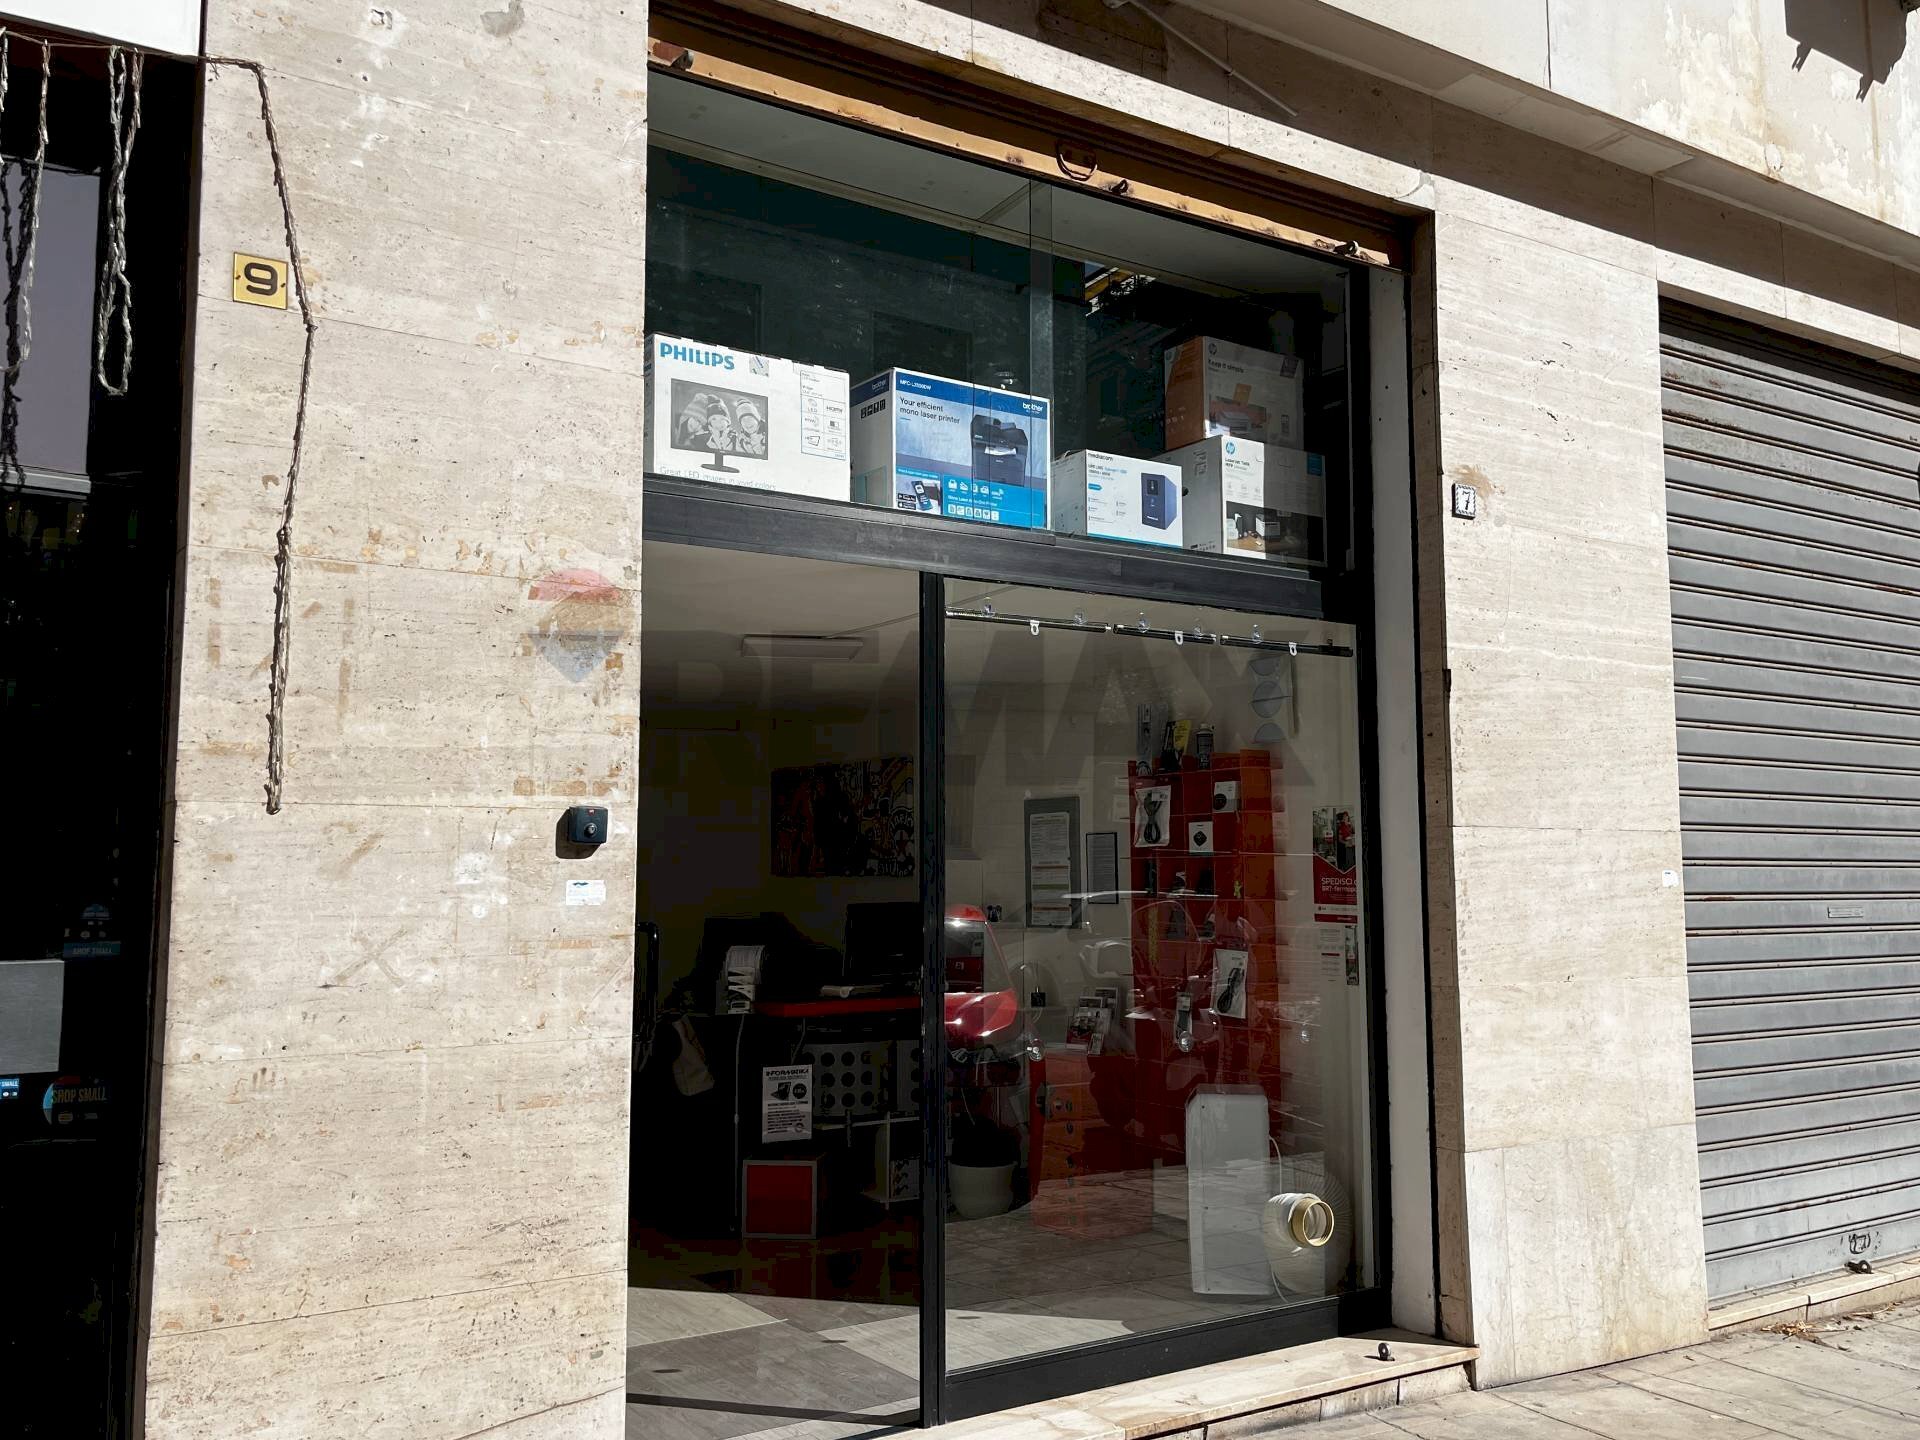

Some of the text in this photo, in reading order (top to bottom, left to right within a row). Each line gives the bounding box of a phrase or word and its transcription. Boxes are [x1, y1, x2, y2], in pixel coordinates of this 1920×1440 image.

[244, 262, 278, 296] 9
[660, 342, 735, 370] PHILIPS
[826, 405, 843, 414] HDMI
[899, 396, 944, 412] Your efficient
[1022, 402, 1044, 412] brother
[899, 407, 961, 425] mono laser printer
[1088, 453, 1114, 462] mediacom
[659, 466, 681, 477] Great
[684, 471, 700, 479] LED
[1462, 490, 1471, 510] 7
[1321, 877, 1353, 886] SPEDISCI
[53, 1086, 108, 1104] SHOP SMALL
